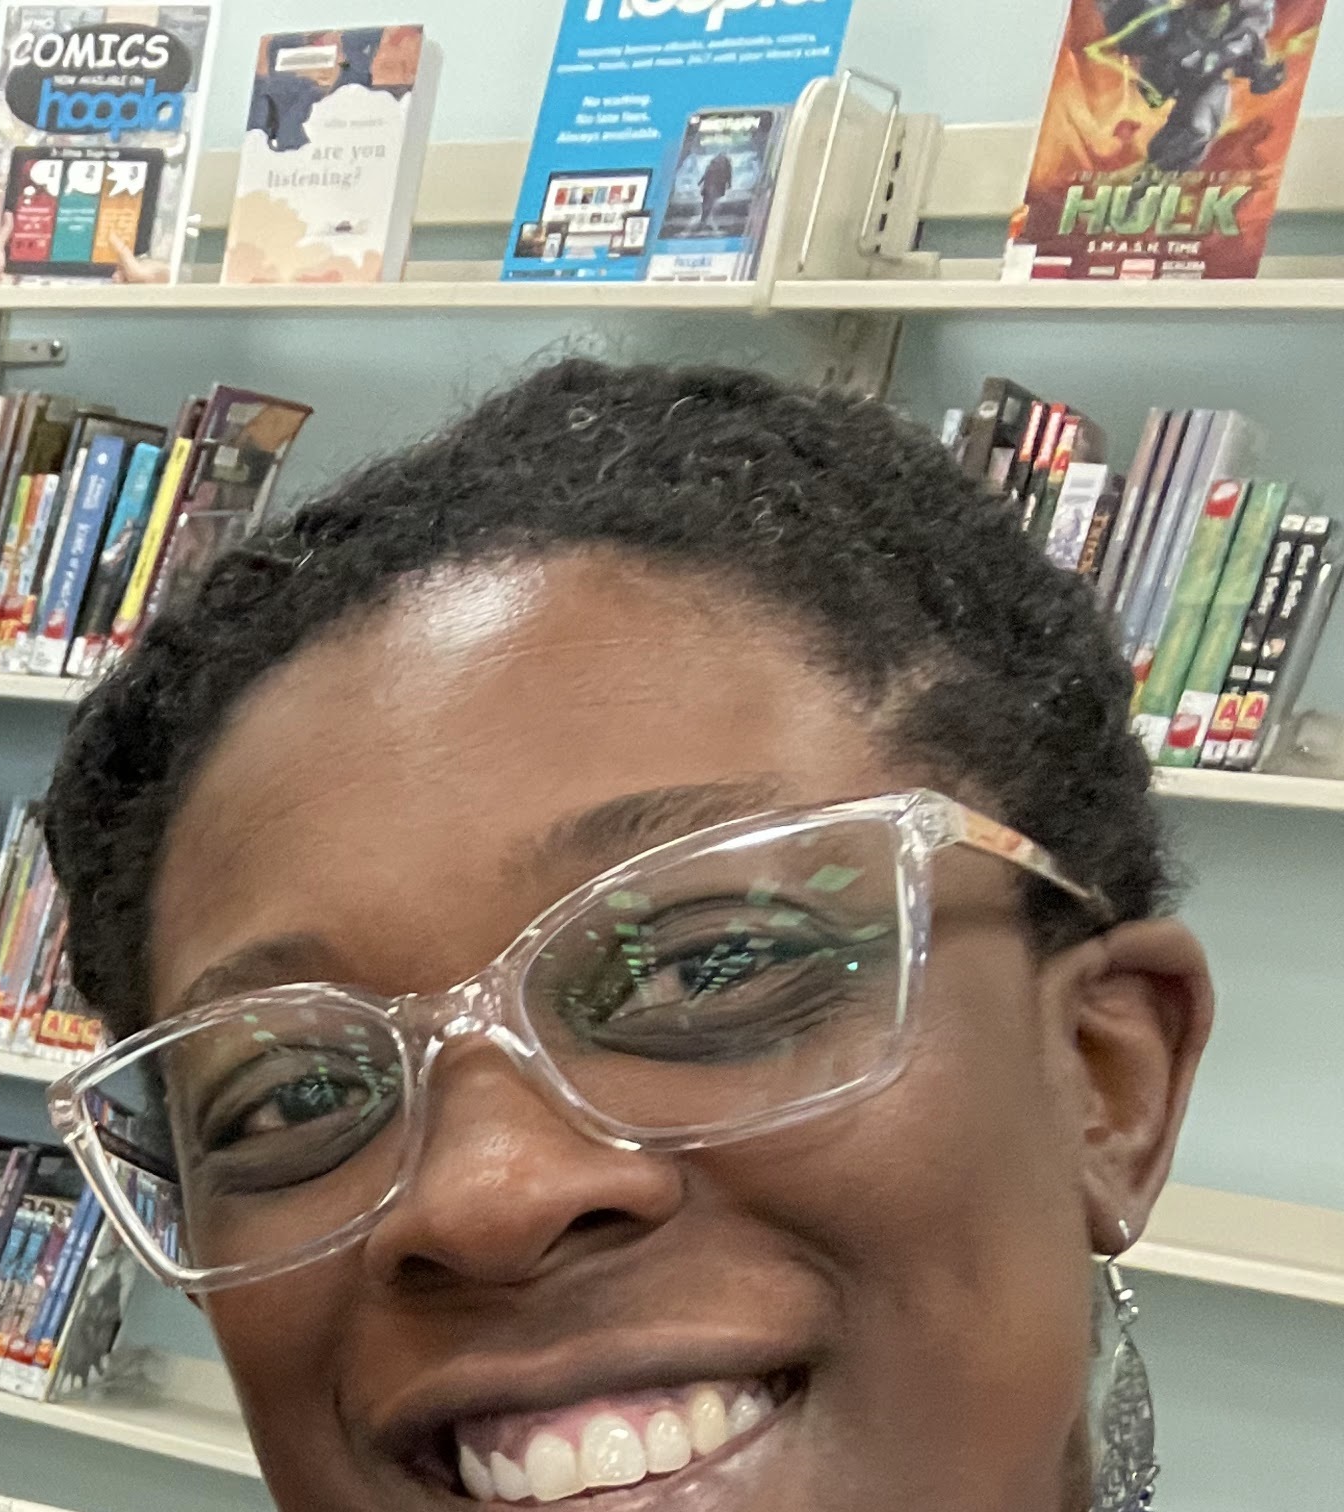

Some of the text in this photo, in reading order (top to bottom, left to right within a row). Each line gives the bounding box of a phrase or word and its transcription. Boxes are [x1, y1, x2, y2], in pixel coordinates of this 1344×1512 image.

[10, 32, 170, 69] COMICS
[37, 76, 185, 142] hoopla
[1058, 185, 1252, 236] HULK
